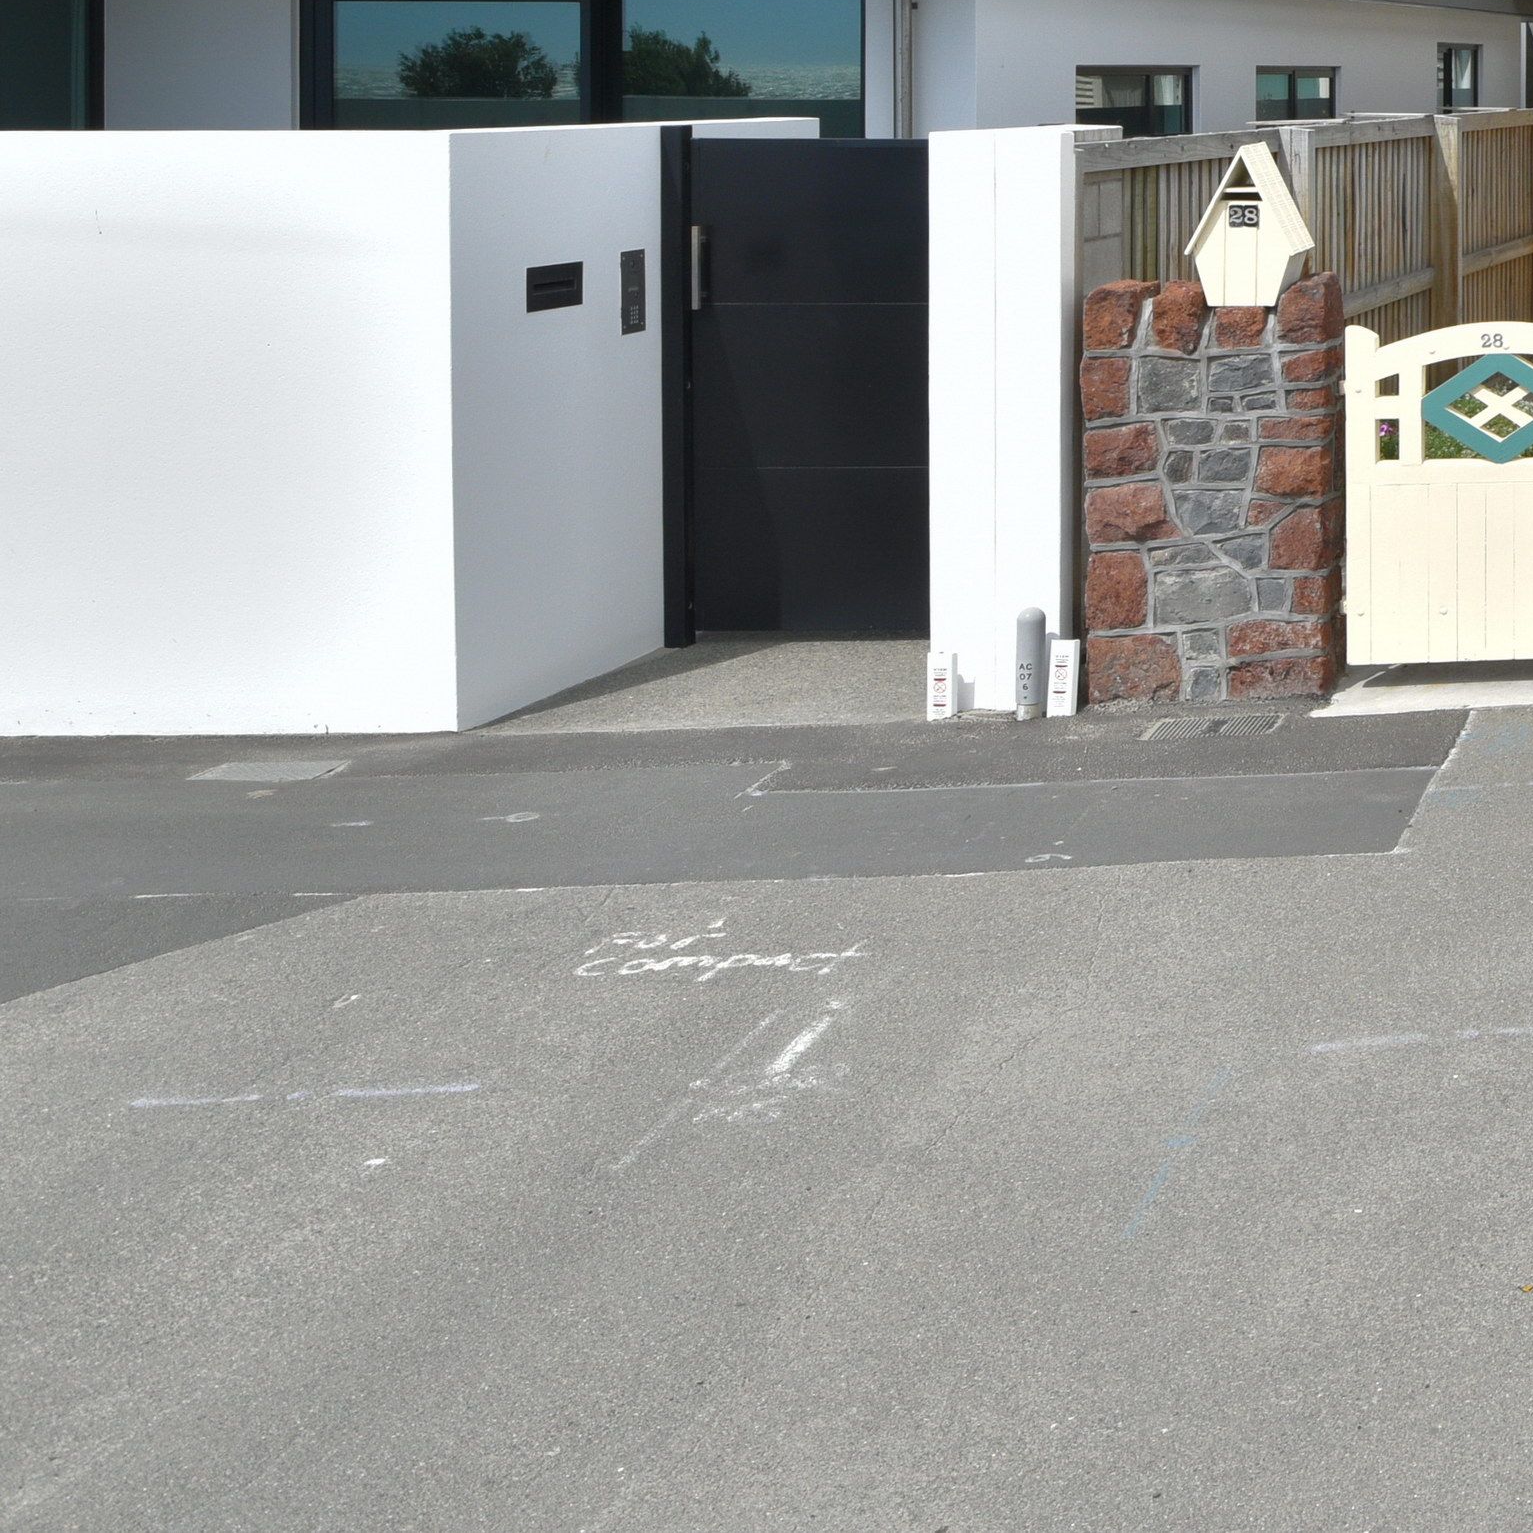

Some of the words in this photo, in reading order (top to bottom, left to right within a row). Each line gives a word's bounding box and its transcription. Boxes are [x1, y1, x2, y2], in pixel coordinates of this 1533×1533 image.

[1229, 207, 1258, 224] 28
[1480, 333, 1503, 348] 28
[1018, 663, 1033, 671] AC
[1022, 683, 1029, 691] 6
